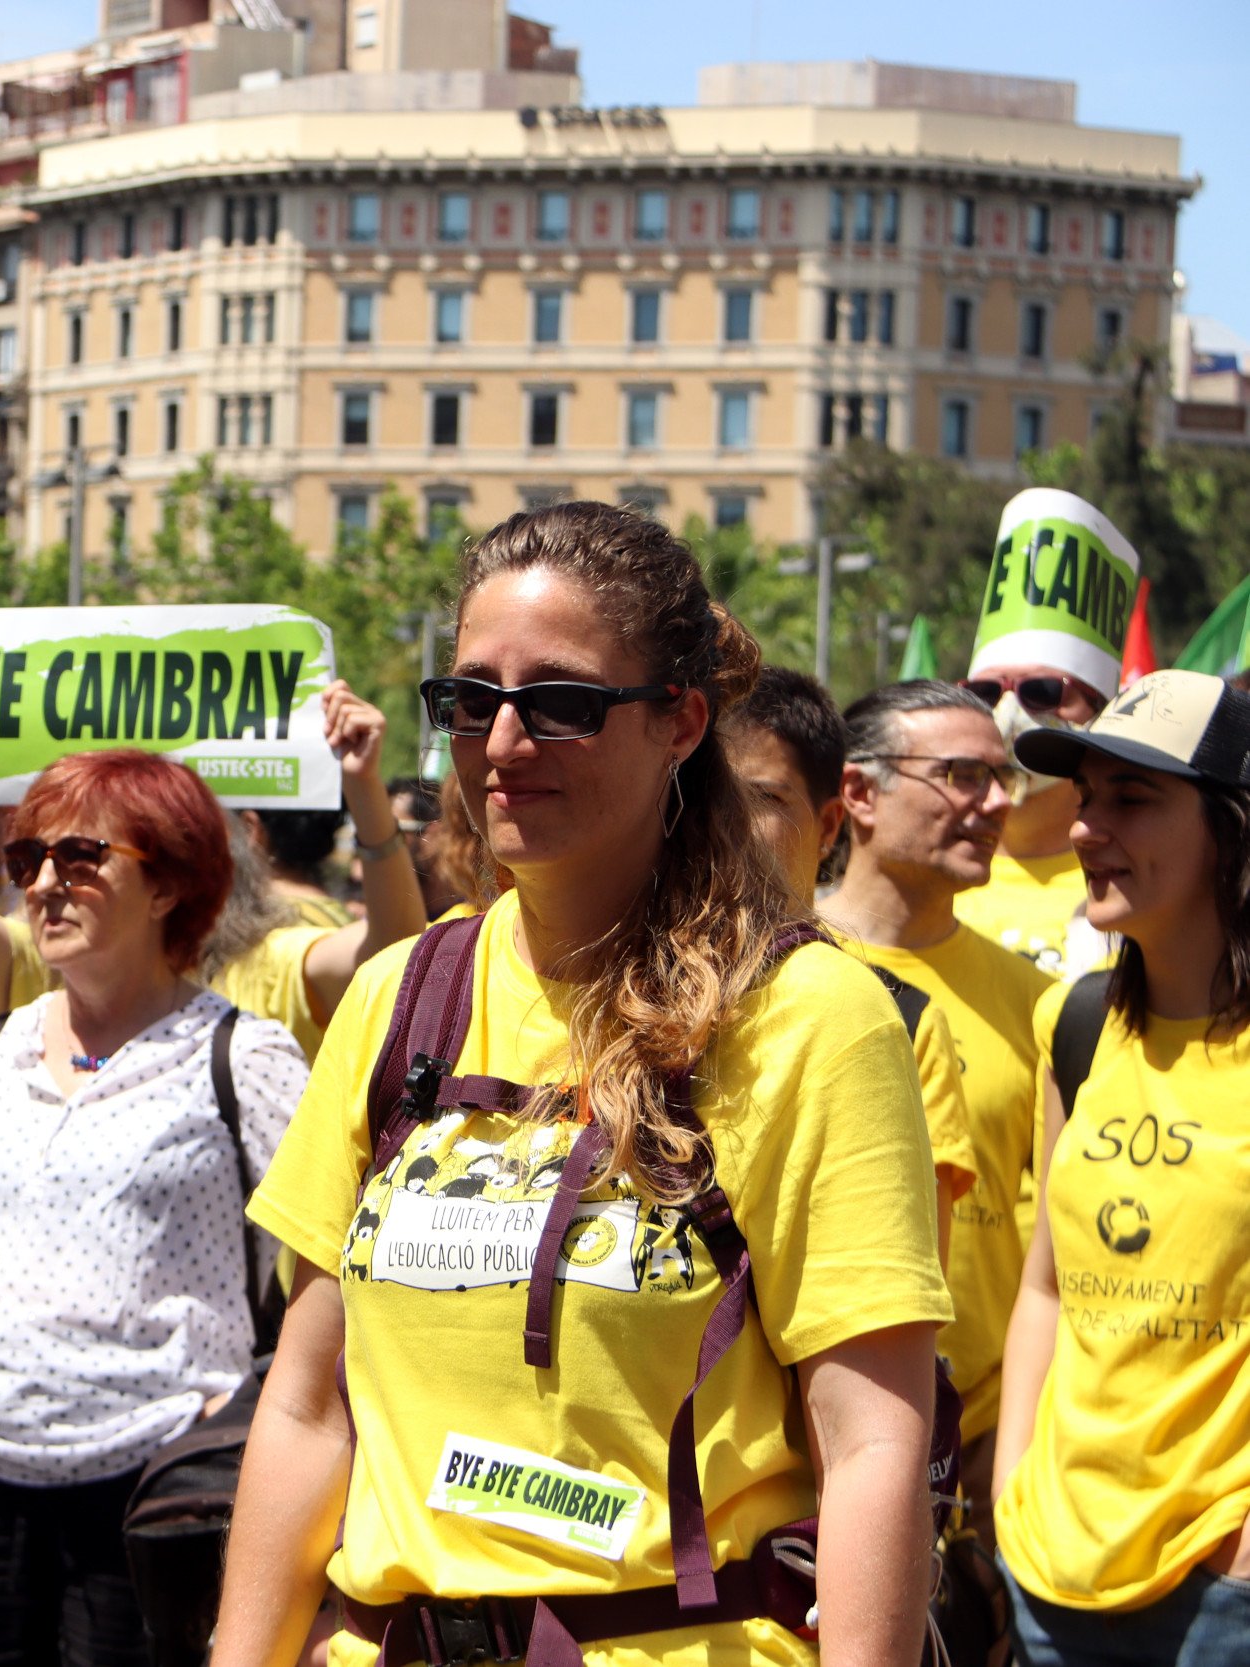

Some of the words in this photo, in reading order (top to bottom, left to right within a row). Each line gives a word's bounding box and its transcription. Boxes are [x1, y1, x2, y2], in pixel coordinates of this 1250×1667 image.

[1022, 528, 1129, 654] CAMB
[43, 650, 304, 741] CAMBRAY
[1083, 1113, 1202, 1167] SOS
[431, 1205, 499, 1231] LLUITEM
[503, 1206, 533, 1232] PER
[388, 1239, 474, 1271] L'EDUCACIÓ
[484, 1239, 538, 1272] PÚBLIC
[1108, 1312, 1248, 1342] QUALITAT
[444, 1450, 484, 1489] BYE
[482, 1460, 524, 1499] BYE
[522, 1470, 626, 1531] CAMBRAY
